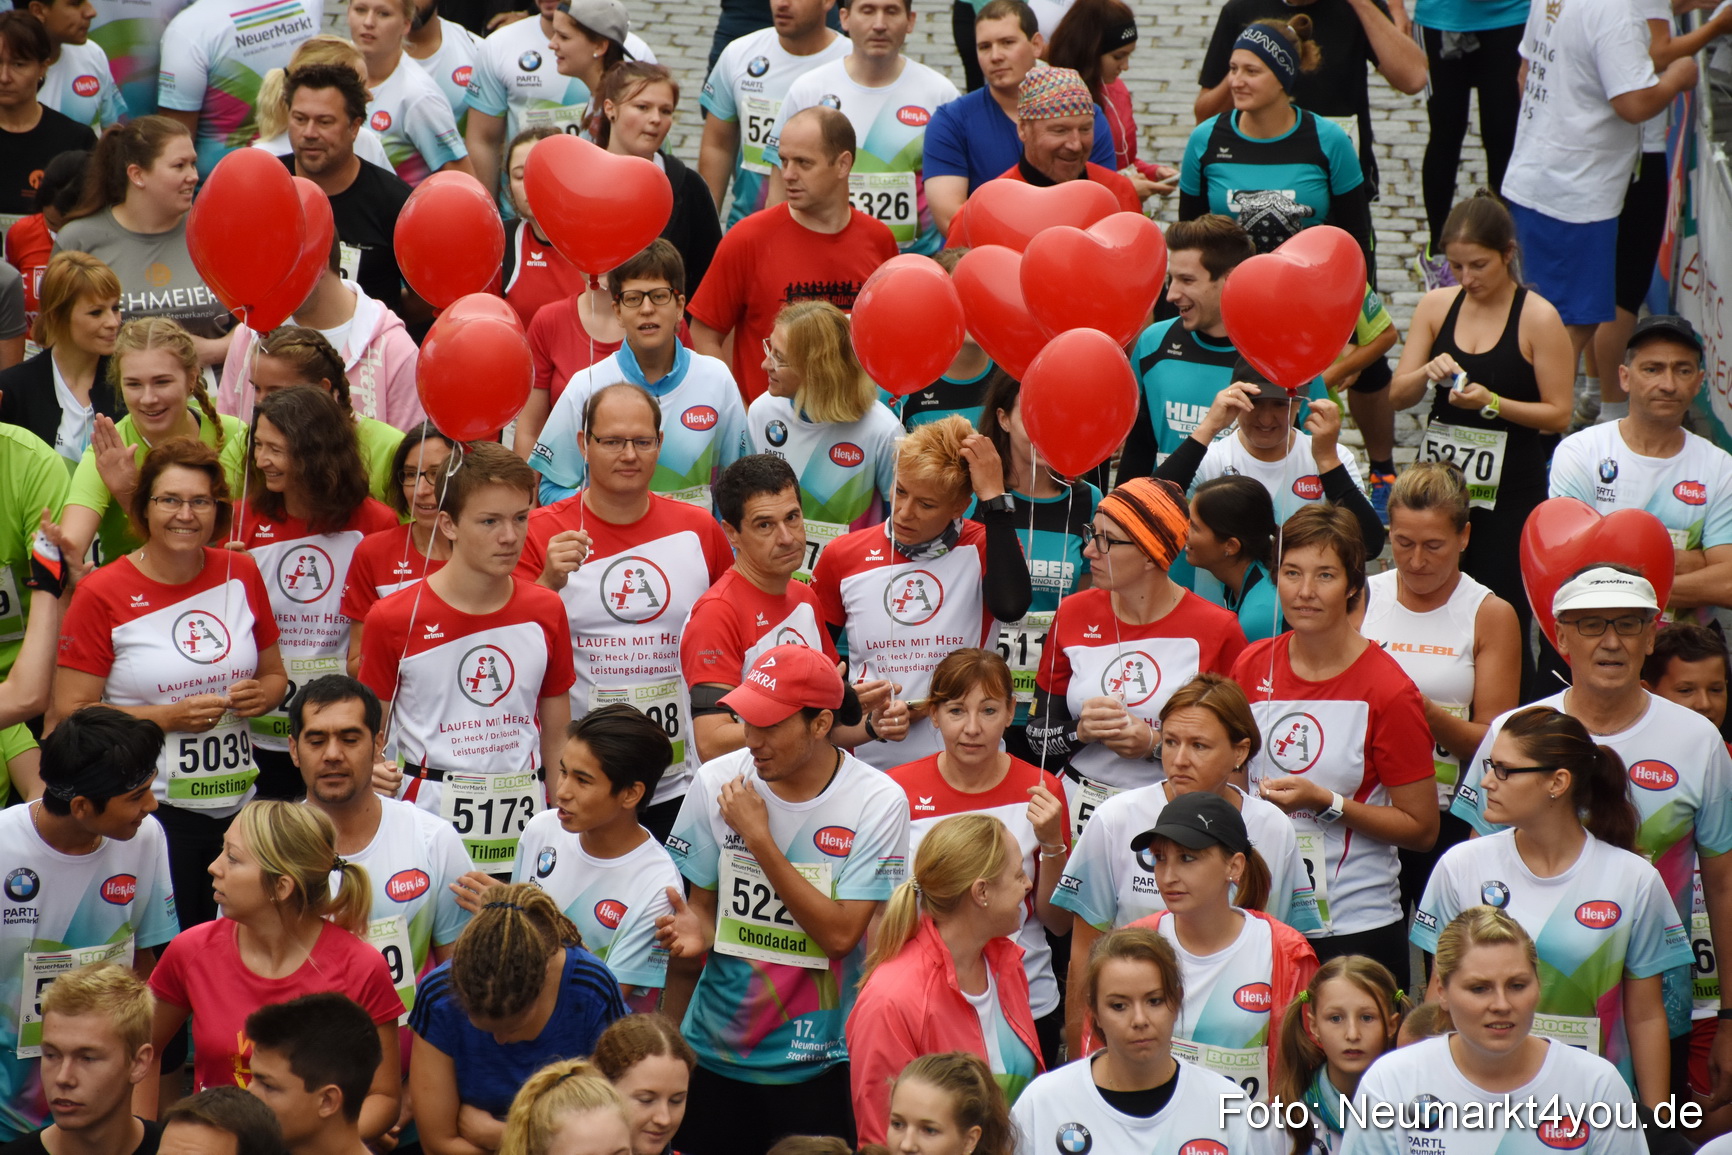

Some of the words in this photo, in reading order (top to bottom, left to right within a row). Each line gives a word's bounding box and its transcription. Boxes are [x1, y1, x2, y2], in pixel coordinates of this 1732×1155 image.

[235, 16, 313, 49] NeuerMarkt
[516, 75, 542, 83] PARTL
[741, 79, 764, 89] PARTL
[901, 108, 927, 123] Hervis
[526, 259, 547, 267] erima
[686, 412, 715, 426] Hervis
[1454, 428, 1499, 444] BOCK
[834, 447, 861, 463] Hervis
[1426, 440, 1496, 482] 5270
[301, 614, 320, 623] MIT
[316, 628, 341, 636] Röschl
[423, 632, 444, 640] erima
[576, 636, 626, 648] LAUFEN
[632, 636, 655, 647] MIT
[865, 639, 906, 651] LAUFEN
[910, 638, 931, 647] MIT
[935, 635, 964, 646] HERZ
[1391, 642, 1460, 657] KLEBL
[589, 653, 603, 662] Dr.
[605, 652, 629, 662] Heck
[637, 652, 651, 661] Dr.
[652, 651, 679, 660] Röschl
[915, 652, 927, 660] Dr.
[291, 657, 339, 671] BOCK
[590, 665, 678, 677] Leistungsdiagnostik
[157, 678, 203, 694] LAUFEN
[207, 673, 227, 684] MIT
[747, 669, 777, 691] DEKRA
[635, 682, 678, 699] BOCK
[439, 719, 482, 734] LAUFEN
[451, 736, 463, 745] Dr.
[464, 733, 484, 742] Heck
[490, 732, 501, 740] Dr.
[179, 730, 251, 774] 5039
[493, 774, 532, 790] BOCK
[1635, 766, 1674, 784] Hervis
[191, 779, 247, 797] Christina
[452, 783, 488, 792] NeuerMarkt
[452, 796, 534, 835] 5173
[665, 835, 690, 855] CK
[820, 832, 854, 850] Hervis
[470, 845, 515, 860] Tilman
[731, 862, 762, 876] NeuerMarkt
[106, 882, 137, 898] Hervis
[391, 876, 426, 895] Hervis
[1060, 876, 1081, 891] CK
[3, 907, 40, 919] PARTL
[1416, 910, 1437, 929] CK
[1581, 906, 1618, 922] Hervis
[3, 916, 40, 926] Neumarkt
[738, 926, 807, 953] Chodadad
[79, 945, 126, 966] BOCK
[33, 963, 73, 971] NeuerMarkt
[793, 1019, 816, 1039] 17.
[1206, 1049, 1260, 1066] BOCK
